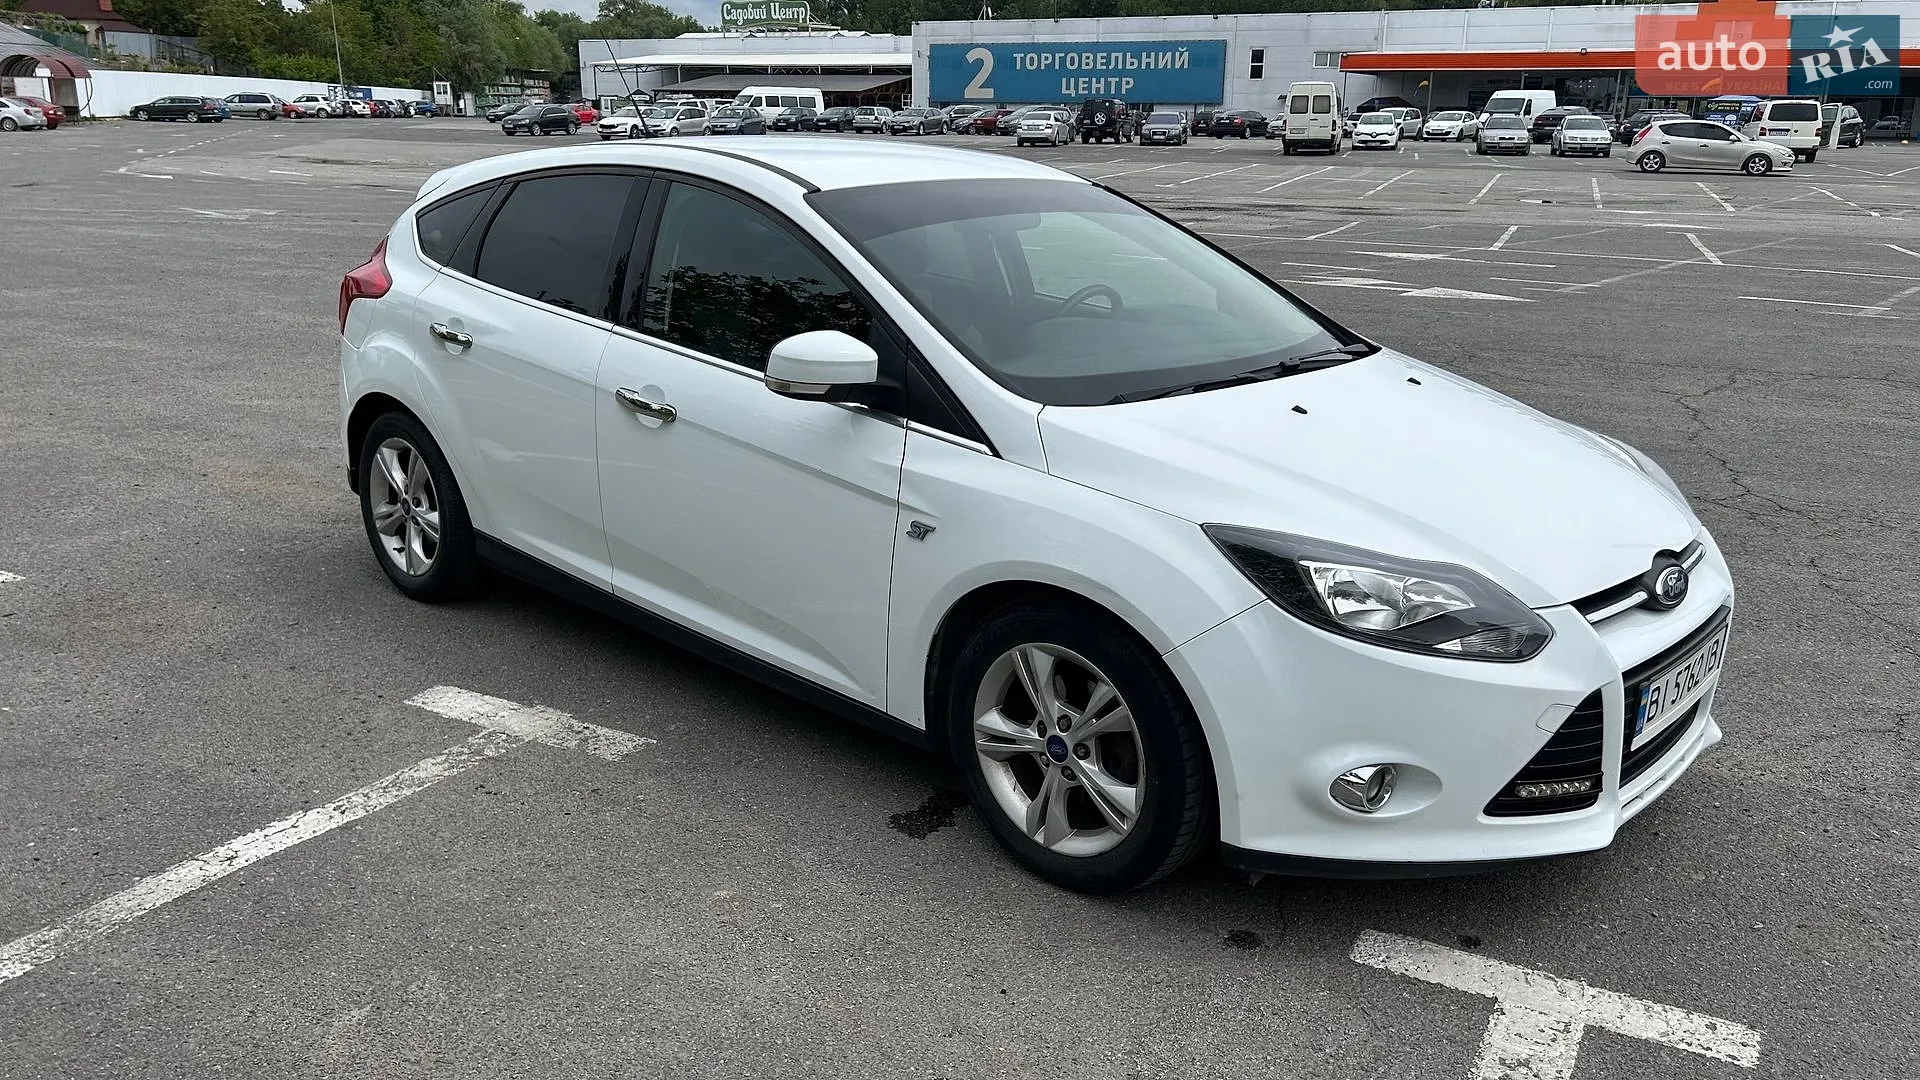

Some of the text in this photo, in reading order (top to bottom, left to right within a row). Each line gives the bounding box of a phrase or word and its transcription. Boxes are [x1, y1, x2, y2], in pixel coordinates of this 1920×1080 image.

[723, 2, 805, 26] Садовий Центр
[1013, 47, 1190, 70] ТОРГОВЕЛЬНИЙ
[964, 47, 994, 99] 2
[1061, 77, 1135, 97] ЦЕНТР
[906, 520, 937, 541] ST
[1667, 572, 1686, 597] Ford
[1646, 638, 1720, 723] BI 5762 IB
